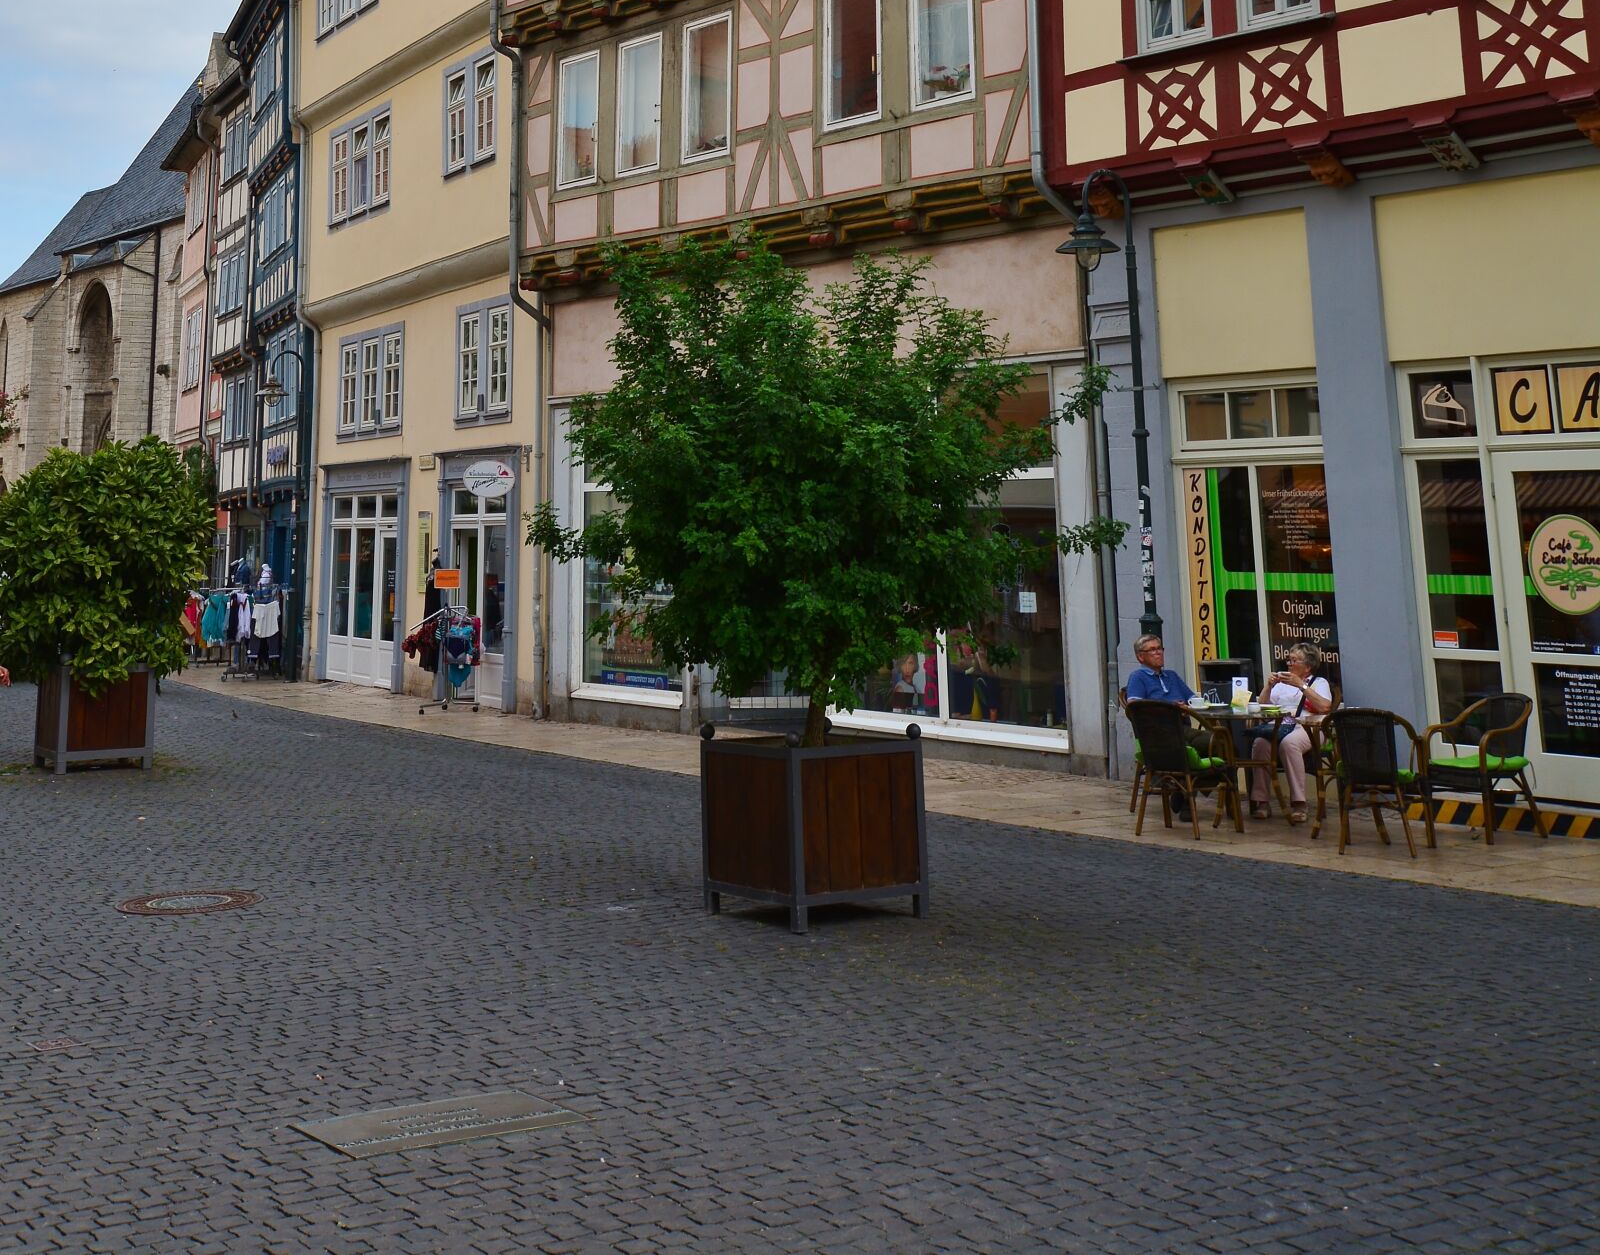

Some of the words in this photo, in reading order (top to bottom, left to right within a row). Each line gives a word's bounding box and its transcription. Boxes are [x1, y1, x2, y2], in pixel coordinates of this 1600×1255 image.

[1276, 489, 1325, 499] Frühstücksangebot
[1189, 473, 1213, 661] KONDITORE
[1282, 599, 1323, 619] Original
[1279, 622, 1330, 643] Thüringer
[1274, 644, 1339, 663] Blehen
